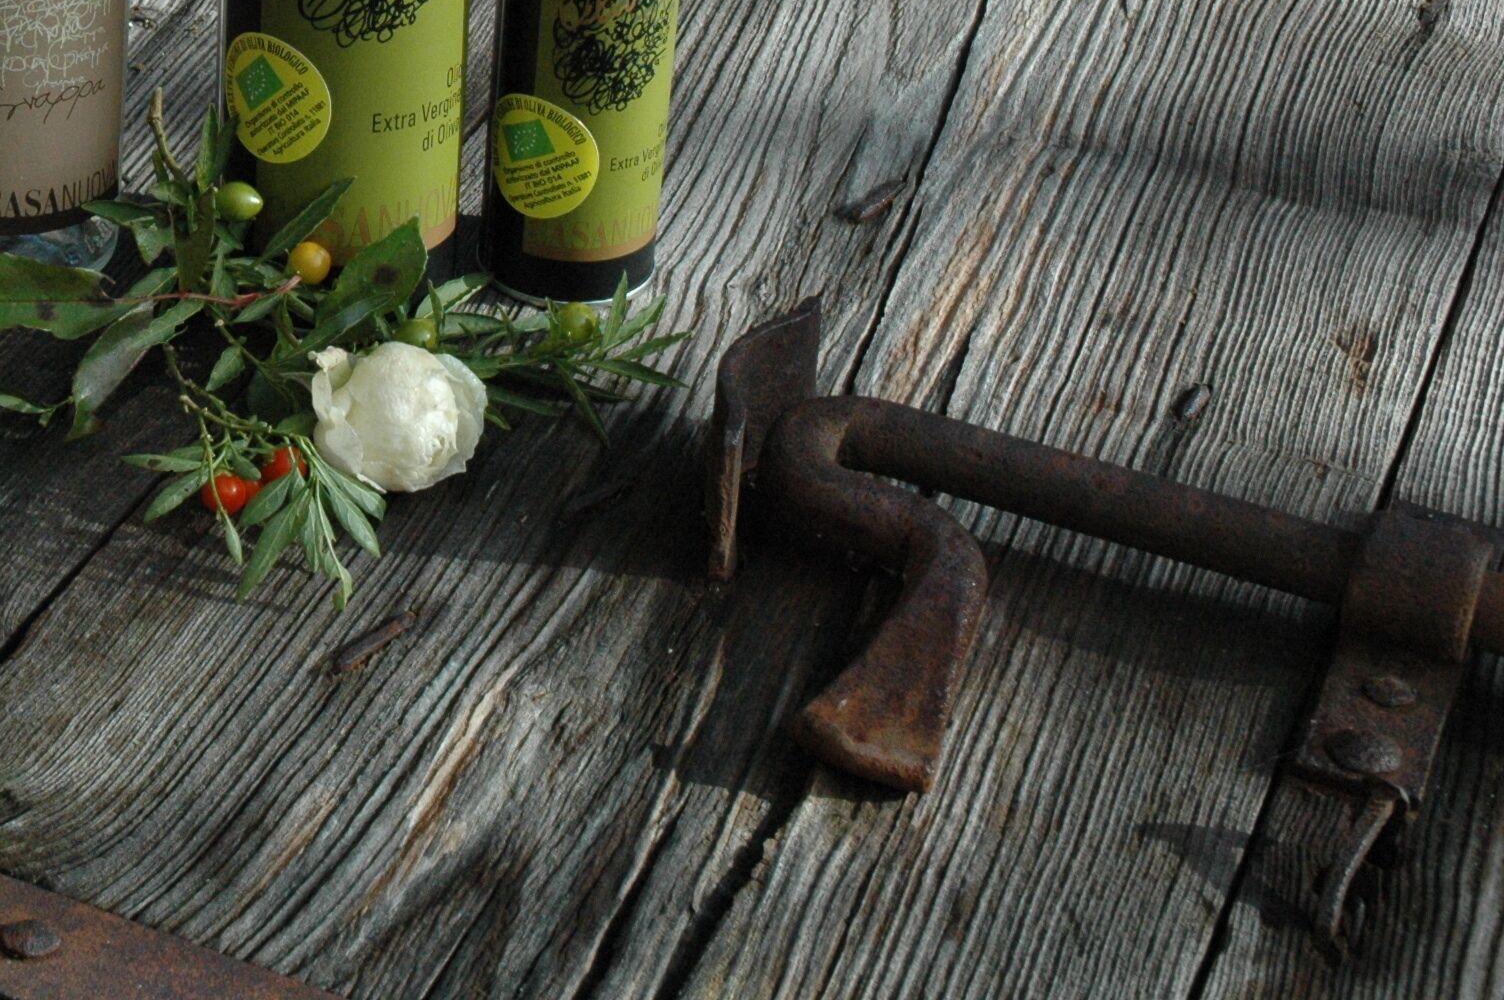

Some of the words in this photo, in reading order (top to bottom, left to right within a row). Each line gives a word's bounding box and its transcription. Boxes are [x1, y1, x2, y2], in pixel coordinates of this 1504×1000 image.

[267, 40, 308, 75] BIOLOGICO
[286, 109, 299, 122] 014
[372, 112, 416, 134] Extra
[546, 109, 586, 146] BIOLOGICO
[422, 128, 434, 151] di
[610, 155, 639, 172] Extra
